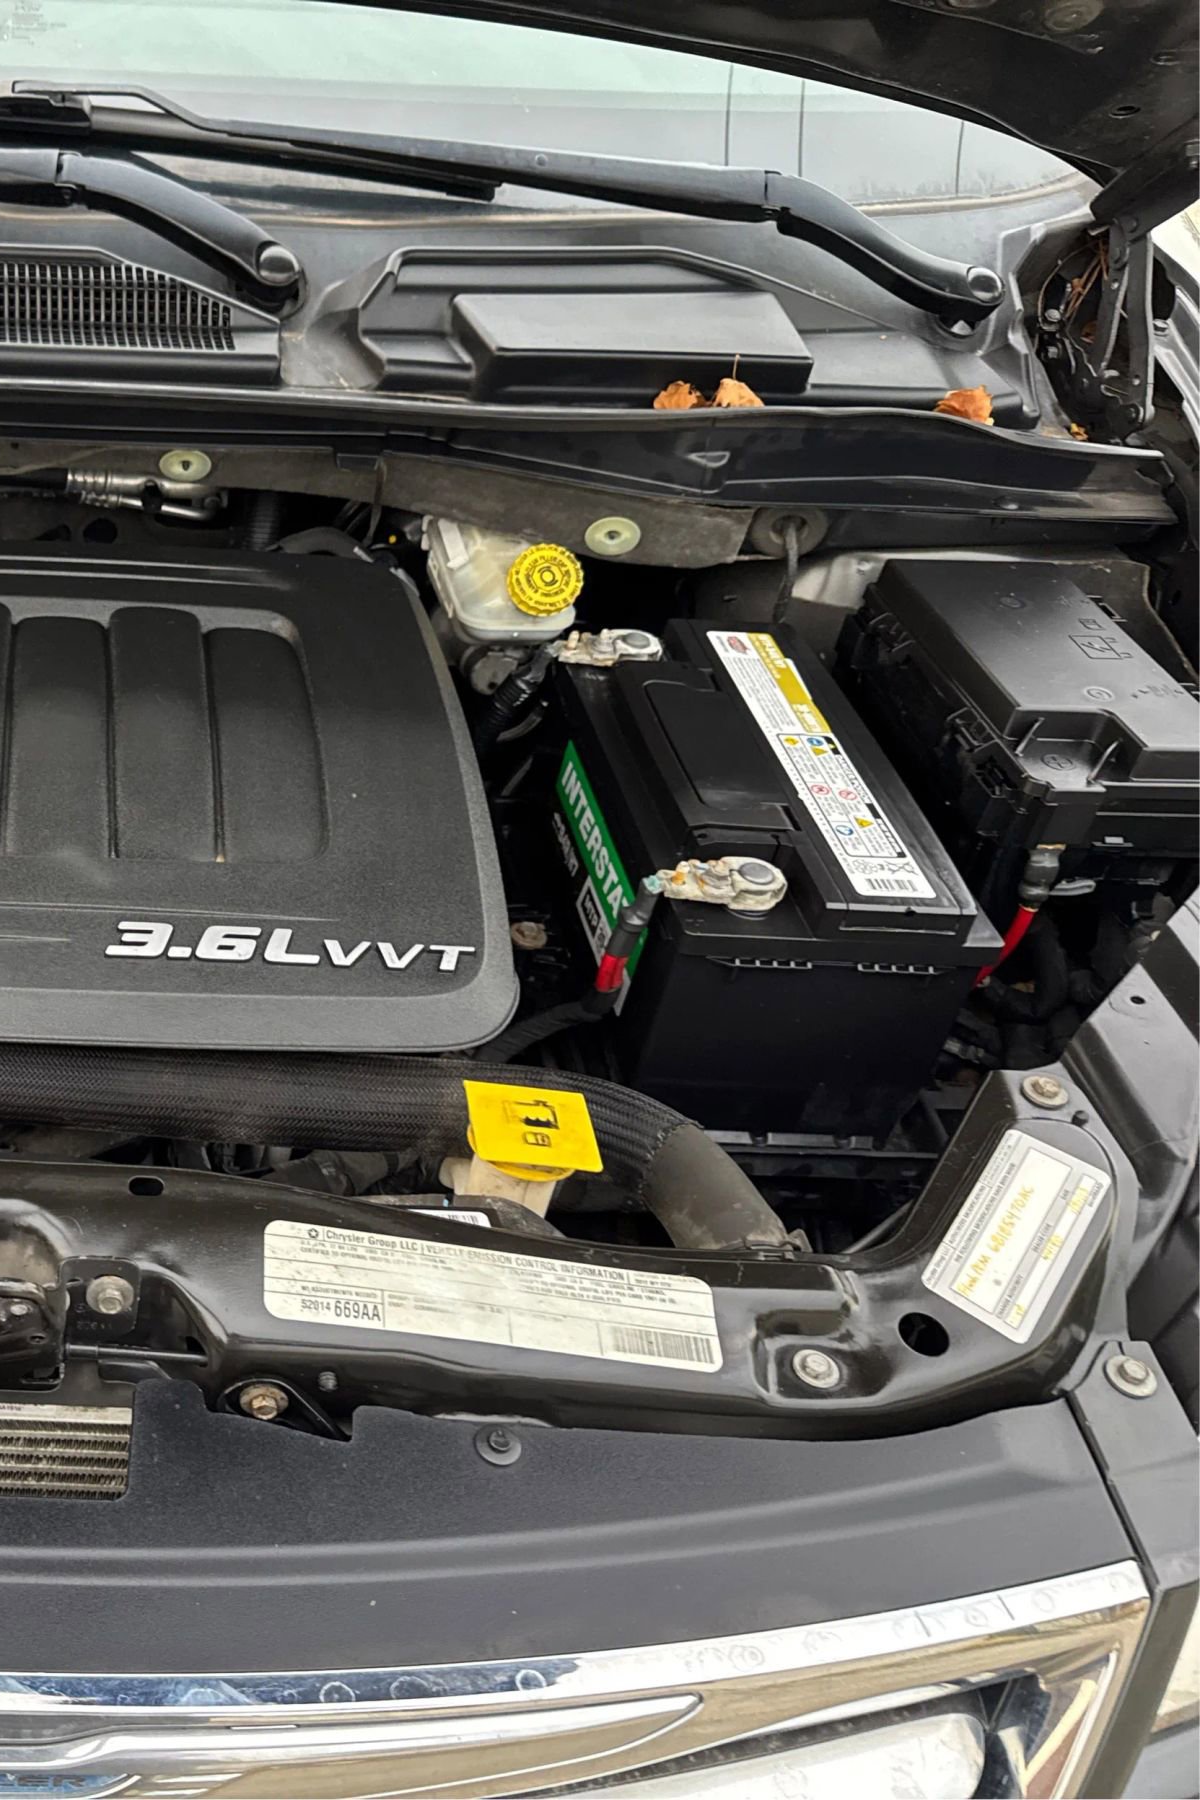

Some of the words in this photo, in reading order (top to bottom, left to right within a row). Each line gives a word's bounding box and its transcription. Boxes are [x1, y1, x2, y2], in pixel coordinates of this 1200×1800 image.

[561, 761, 629, 919] INTERSTA
[104, 921, 321, 965] 3.6L
[323, 938, 476, 972] VVT
[325, 1230, 366, 1244] Chrysler
[368, 1236, 398, 1250] Group
[400, 1238, 418, 1251] LLC
[427, 1244, 463, 1257] VEHICLE
[467, 1249, 513, 1265] EMISSION
[515, 1257, 558, 1272] CONTROL
[560, 1263, 625, 1281] INFORMATION
[301, 1299, 331, 1311] 52014
[334, 1300, 382, 1322] 669AA
